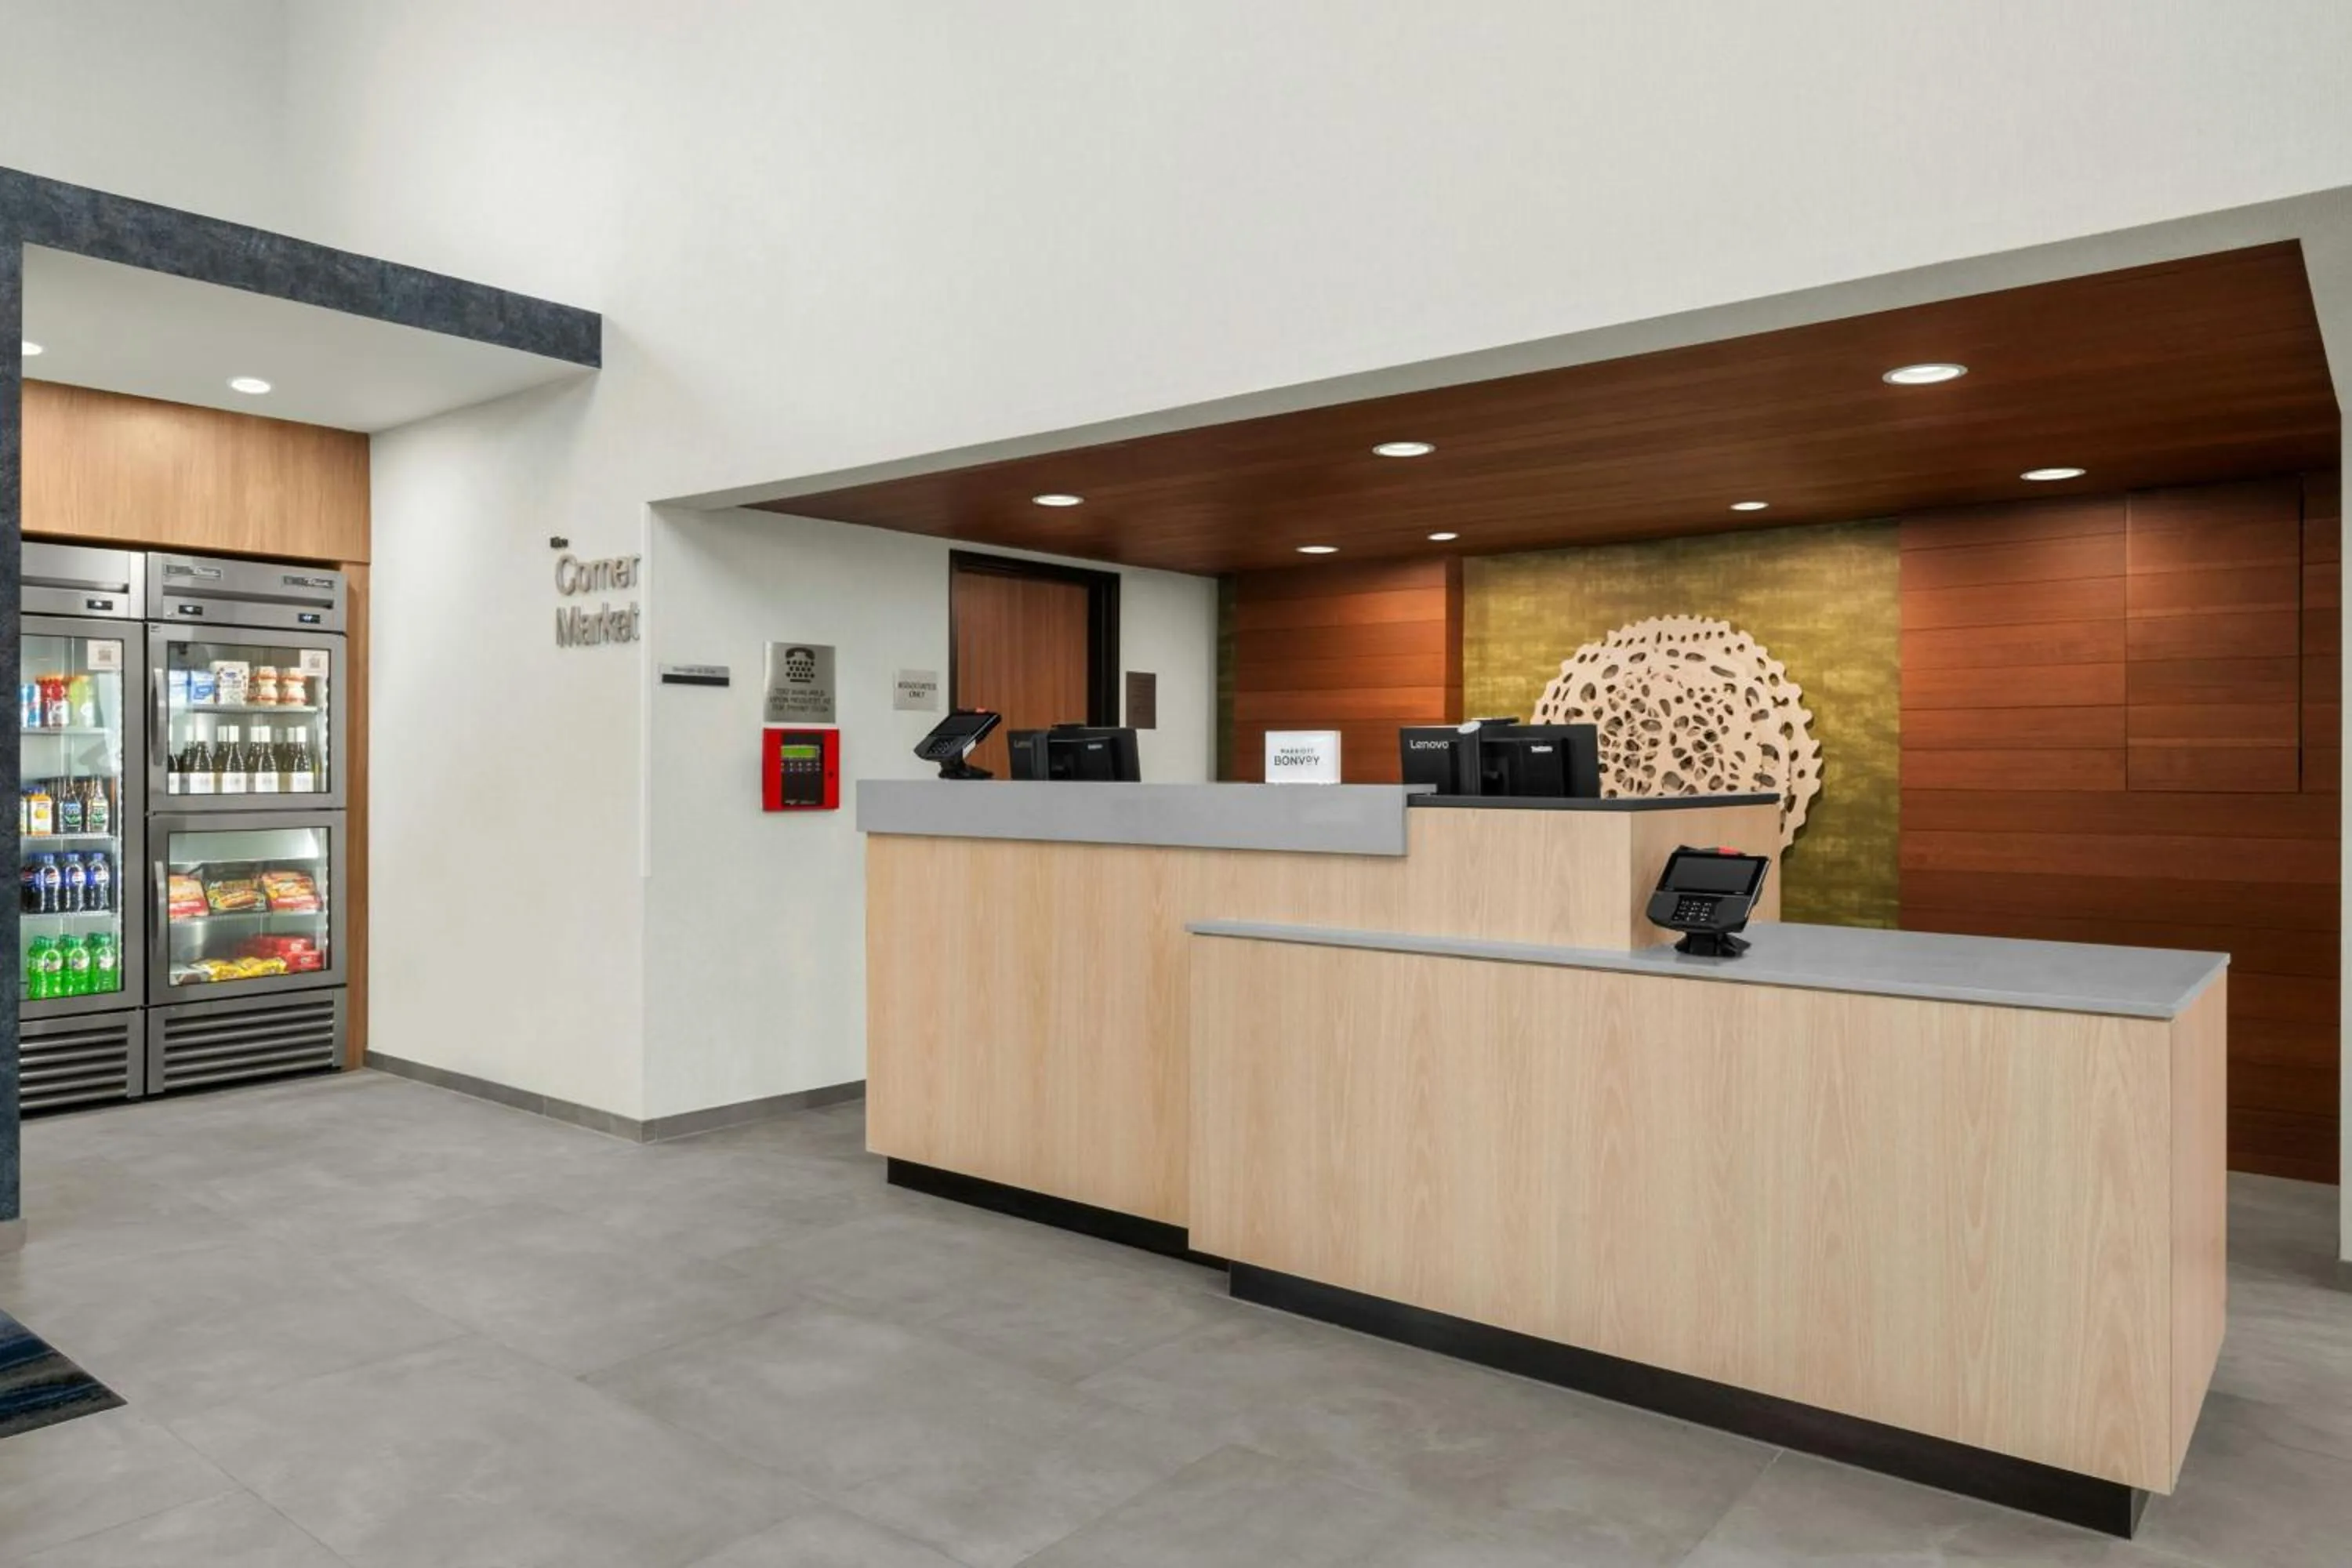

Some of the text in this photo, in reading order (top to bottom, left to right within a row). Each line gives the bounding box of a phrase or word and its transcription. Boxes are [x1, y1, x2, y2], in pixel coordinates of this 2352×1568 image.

[555, 554, 641, 596] Corner
[556, 601, 640, 648] Market
[1410, 739, 1449, 750] Lenovo
[1274, 755, 1320, 766] BONVOY
